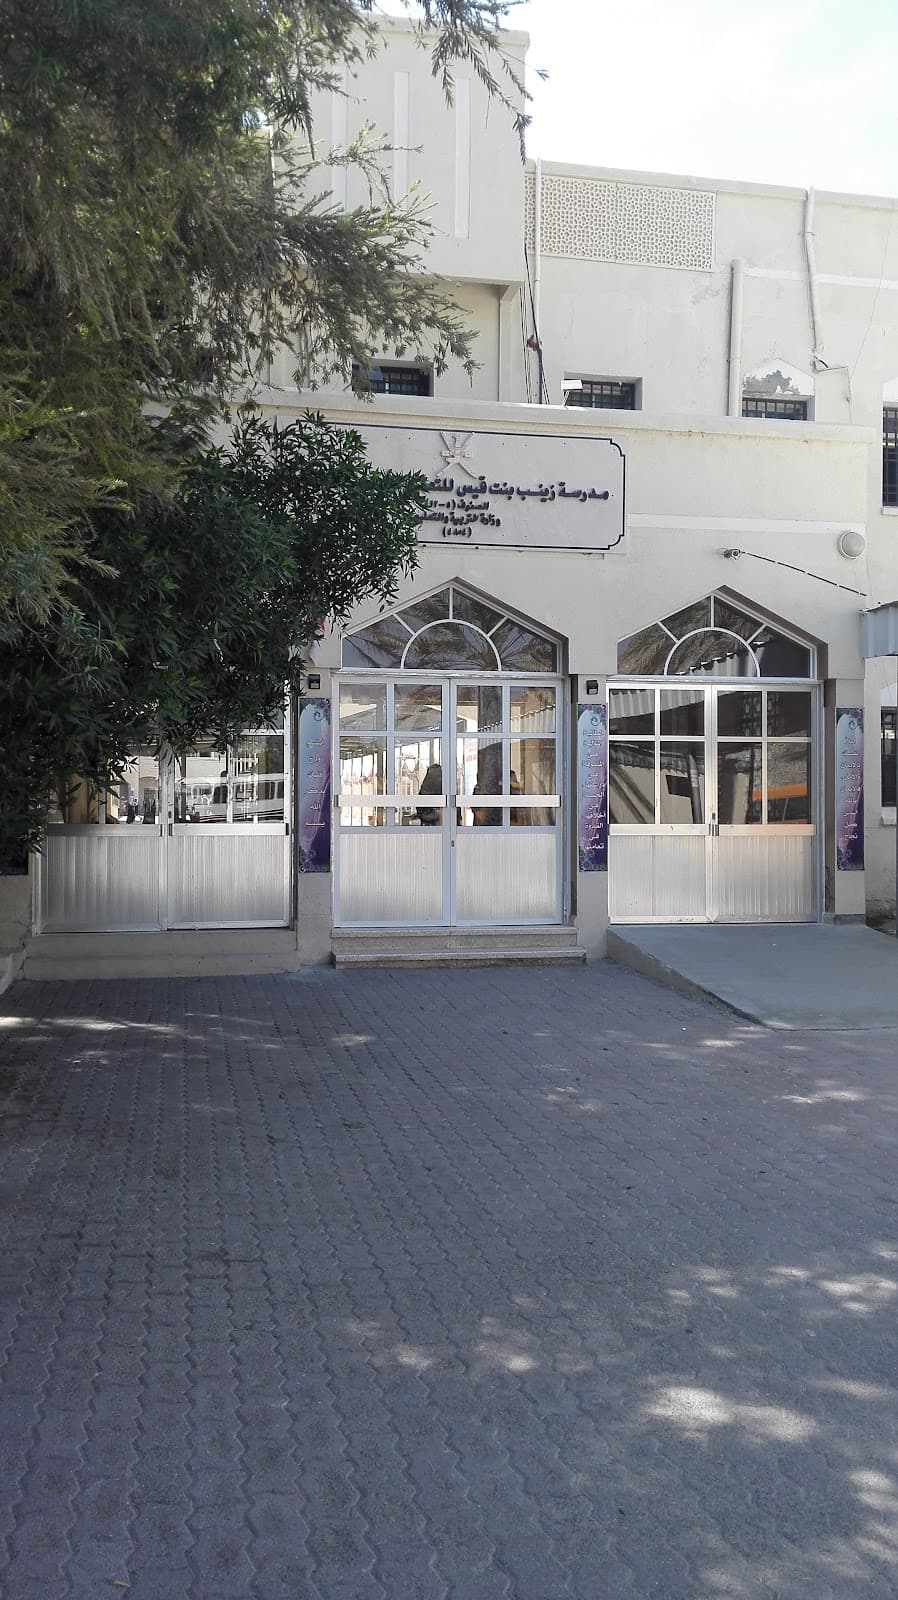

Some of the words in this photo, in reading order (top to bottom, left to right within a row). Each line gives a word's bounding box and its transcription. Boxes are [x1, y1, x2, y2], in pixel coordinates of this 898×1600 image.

[456, 476, 487, 498] قيس
[489, 482, 514, 500] بنت
[516, 484, 556, 502] زينب
[558, 481, 609, 502] مدرسة
[450, 511, 479, 525] التربية
[479, 513, 501, 526] وزارة
